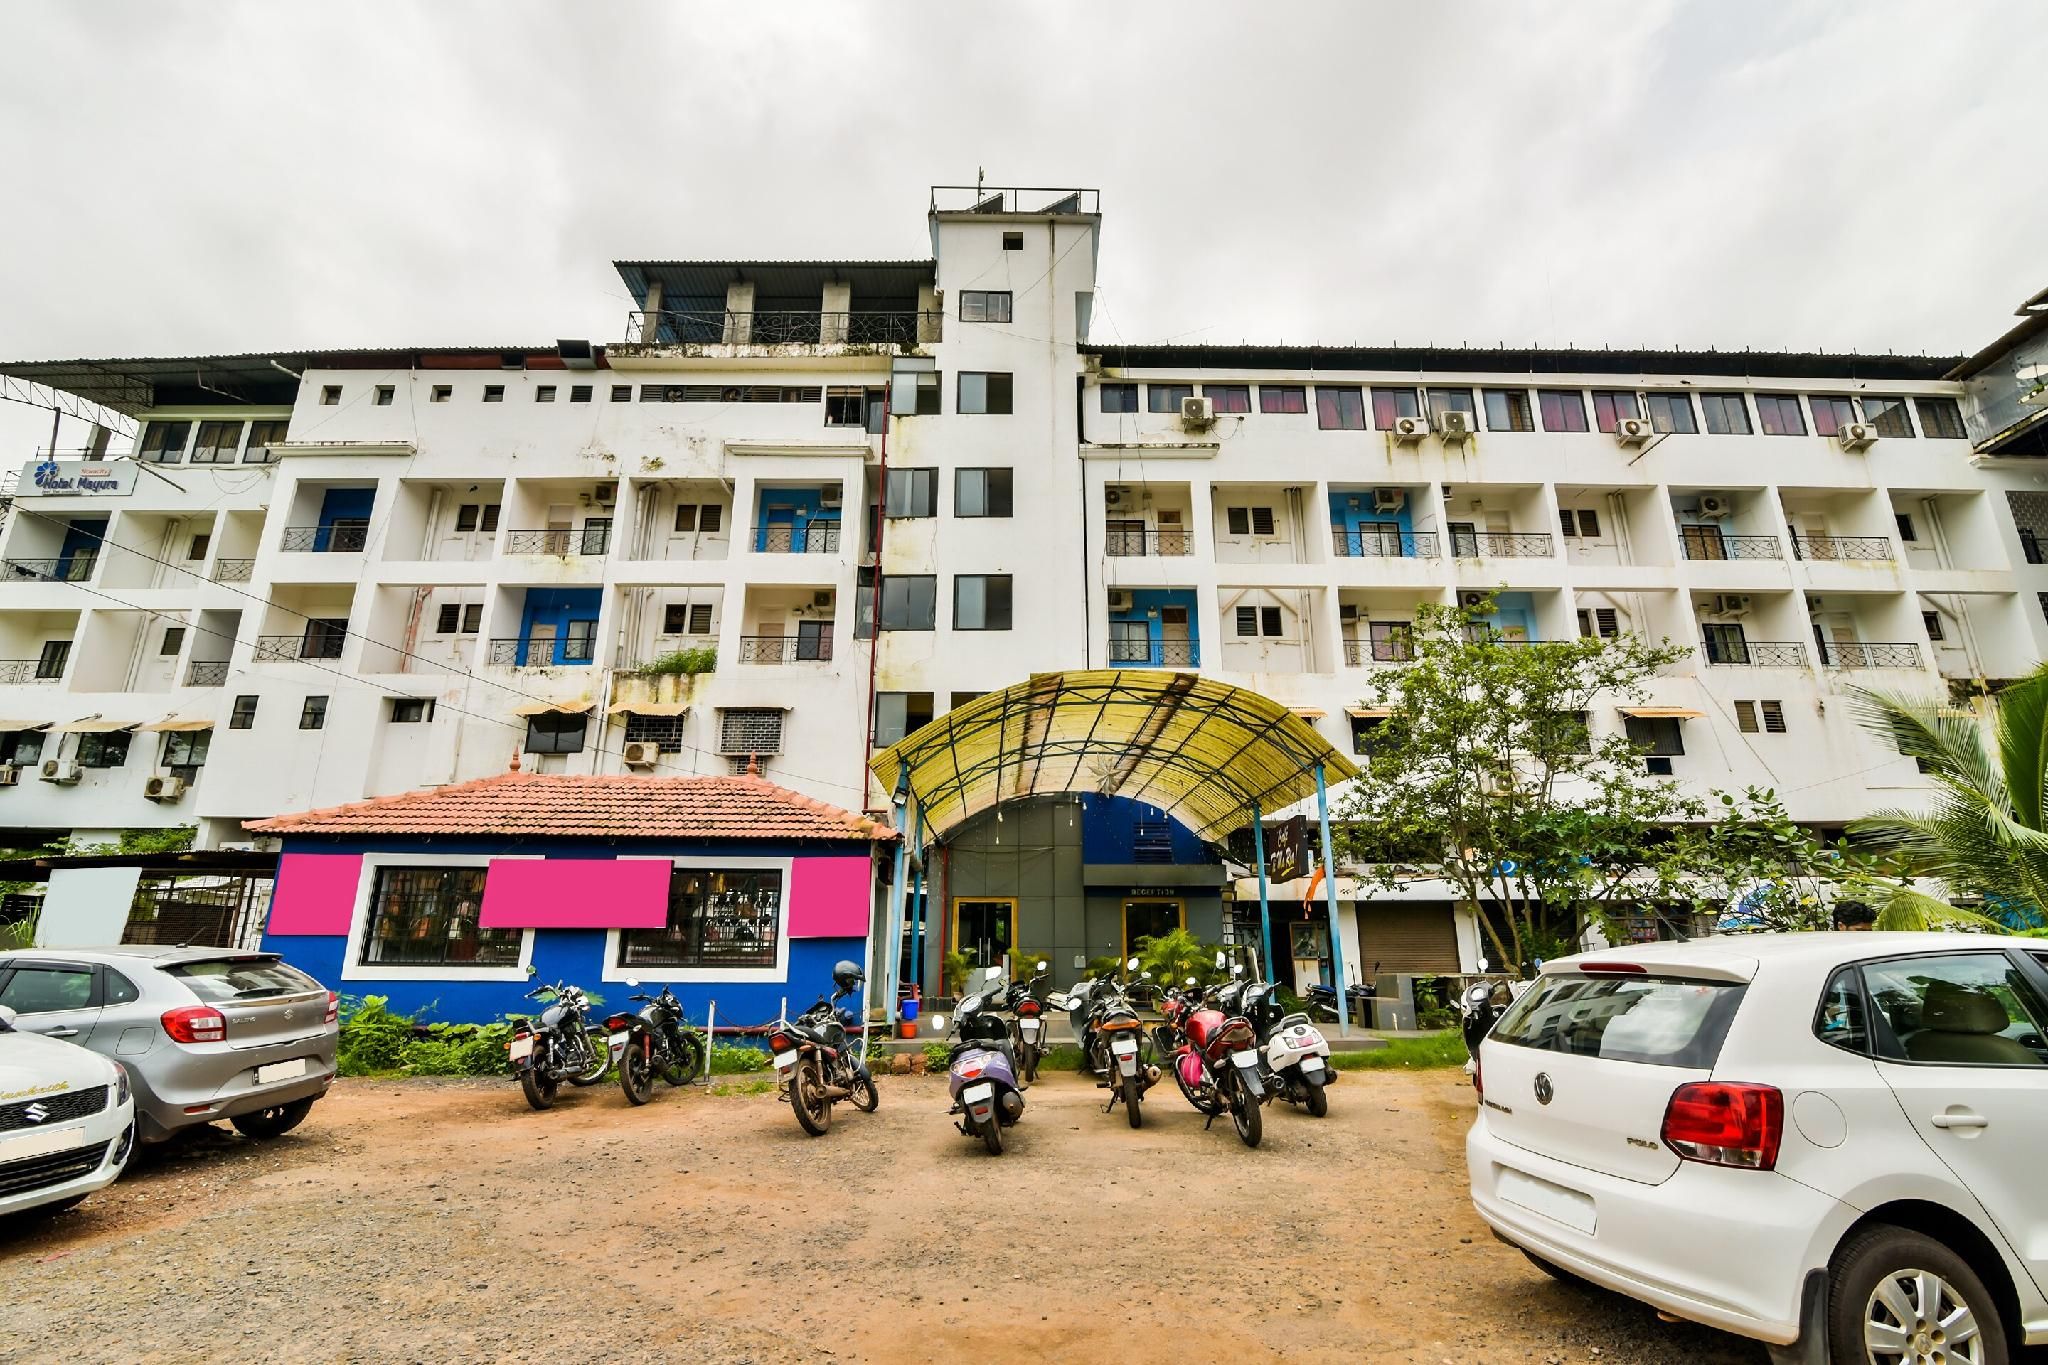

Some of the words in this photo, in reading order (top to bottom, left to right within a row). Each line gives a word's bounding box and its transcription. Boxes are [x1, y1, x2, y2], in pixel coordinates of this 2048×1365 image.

[42, 477, 74, 489] Hotel
[77, 477, 118, 493] Mayura
[1131, 888, 1175, 896] RECEPTION
